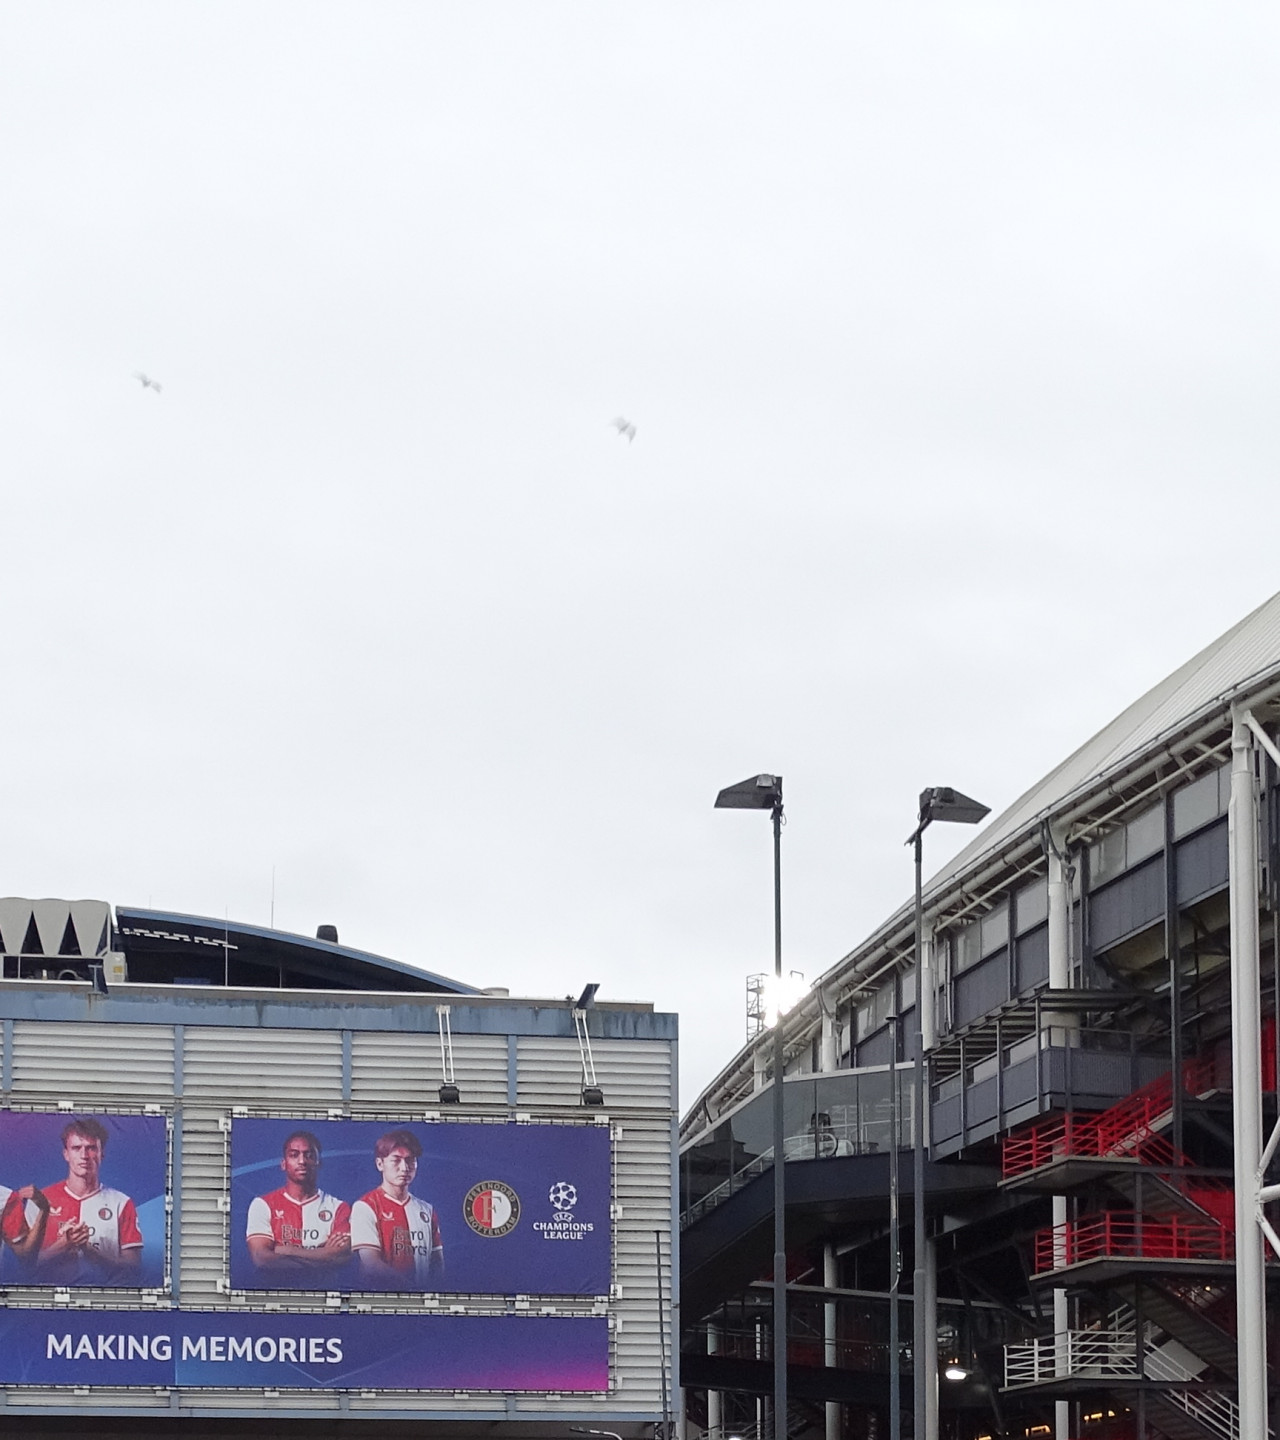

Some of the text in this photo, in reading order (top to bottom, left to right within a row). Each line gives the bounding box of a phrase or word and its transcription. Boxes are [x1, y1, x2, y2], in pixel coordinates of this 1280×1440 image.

[281, 1224, 320, 1240] Euro
[468, 1215, 518, 1236] ROTTERDAM
[533, 1222, 594, 1231] CHAMPIONS
[544, 1231, 583, 1240] LEAGUE
[46, 1334, 344, 1363] MAKING MEMORIES
